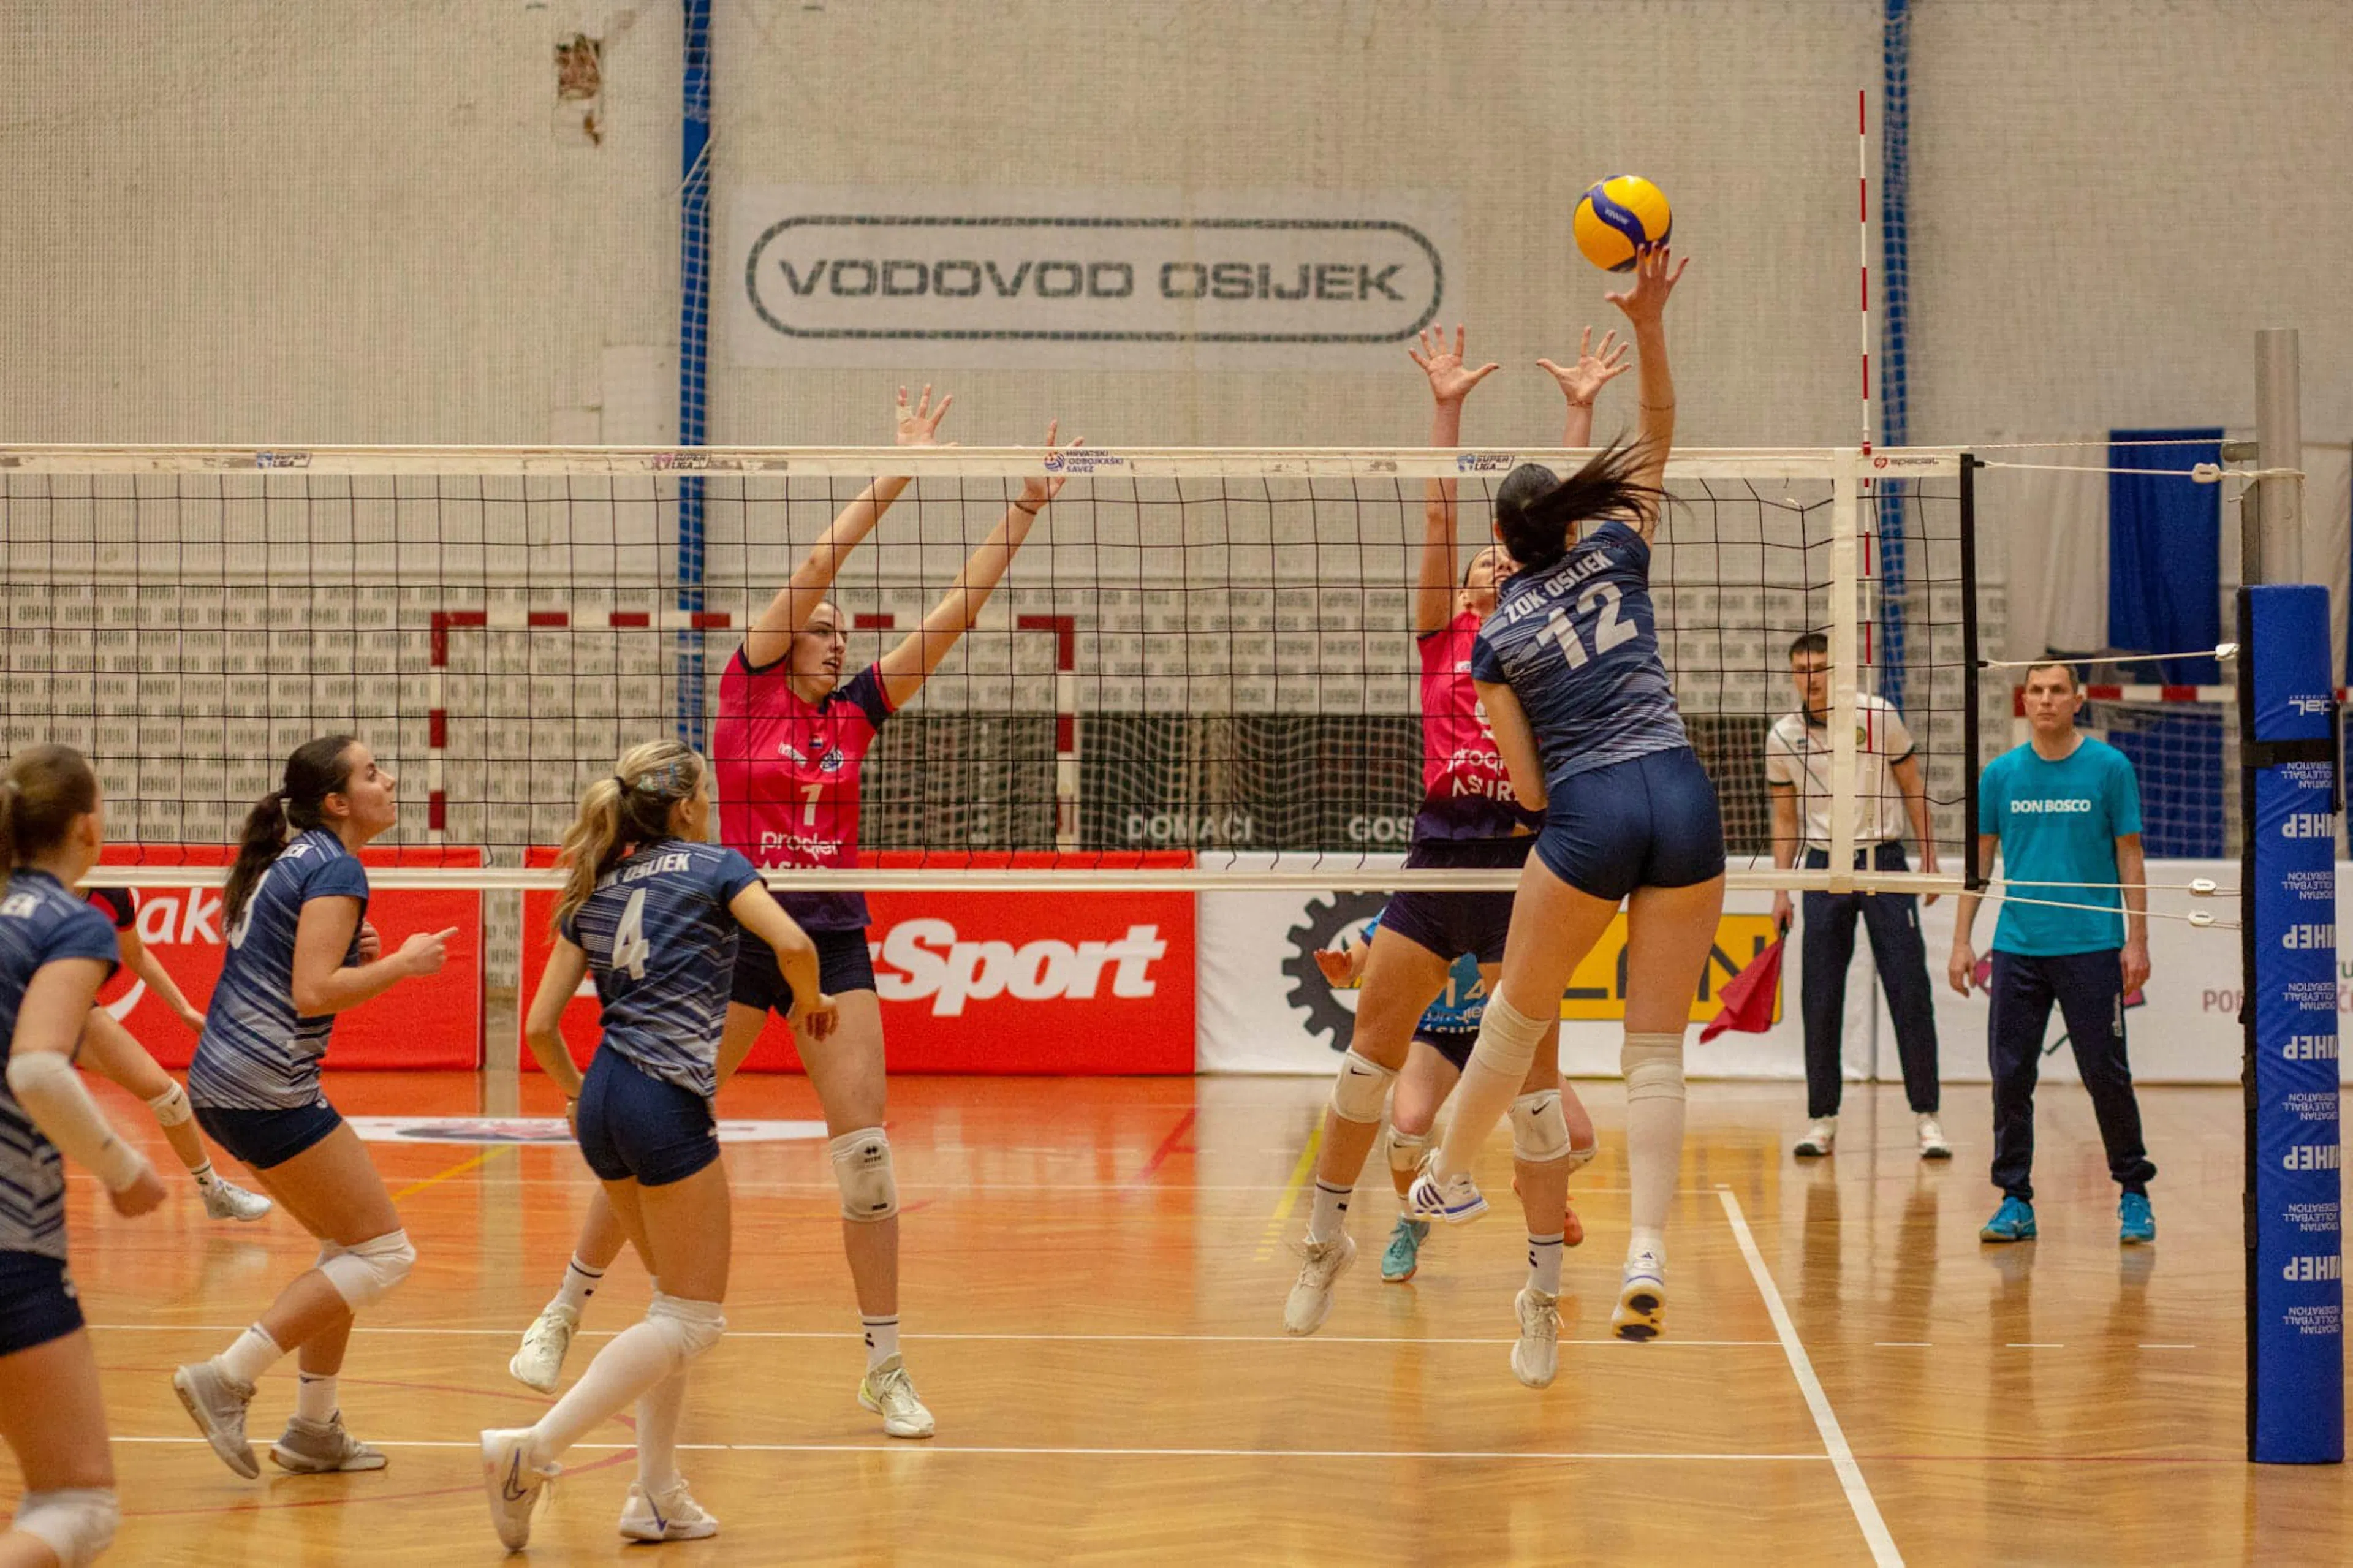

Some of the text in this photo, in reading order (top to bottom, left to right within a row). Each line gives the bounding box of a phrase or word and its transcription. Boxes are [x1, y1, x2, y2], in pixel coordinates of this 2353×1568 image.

[779, 259, 1408, 302] VODOVOD OSIJEK
[1544, 550, 1615, 598] OSIJEK
[1536, 581, 1639, 670] 12
[800, 783, 824, 827] 1
[2010, 798, 2092, 814] DON BOSCO
[1347, 815, 1415, 842] GOS
[612, 887, 650, 980] 4
[2282, 924, 2326, 949] HEP
[868, 918, 1167, 1017] Sport
[2283, 1035, 2328, 1060] HEP
[2283, 1145, 2328, 1170] HEP
[2282, 1256, 2328, 1281] HEP
